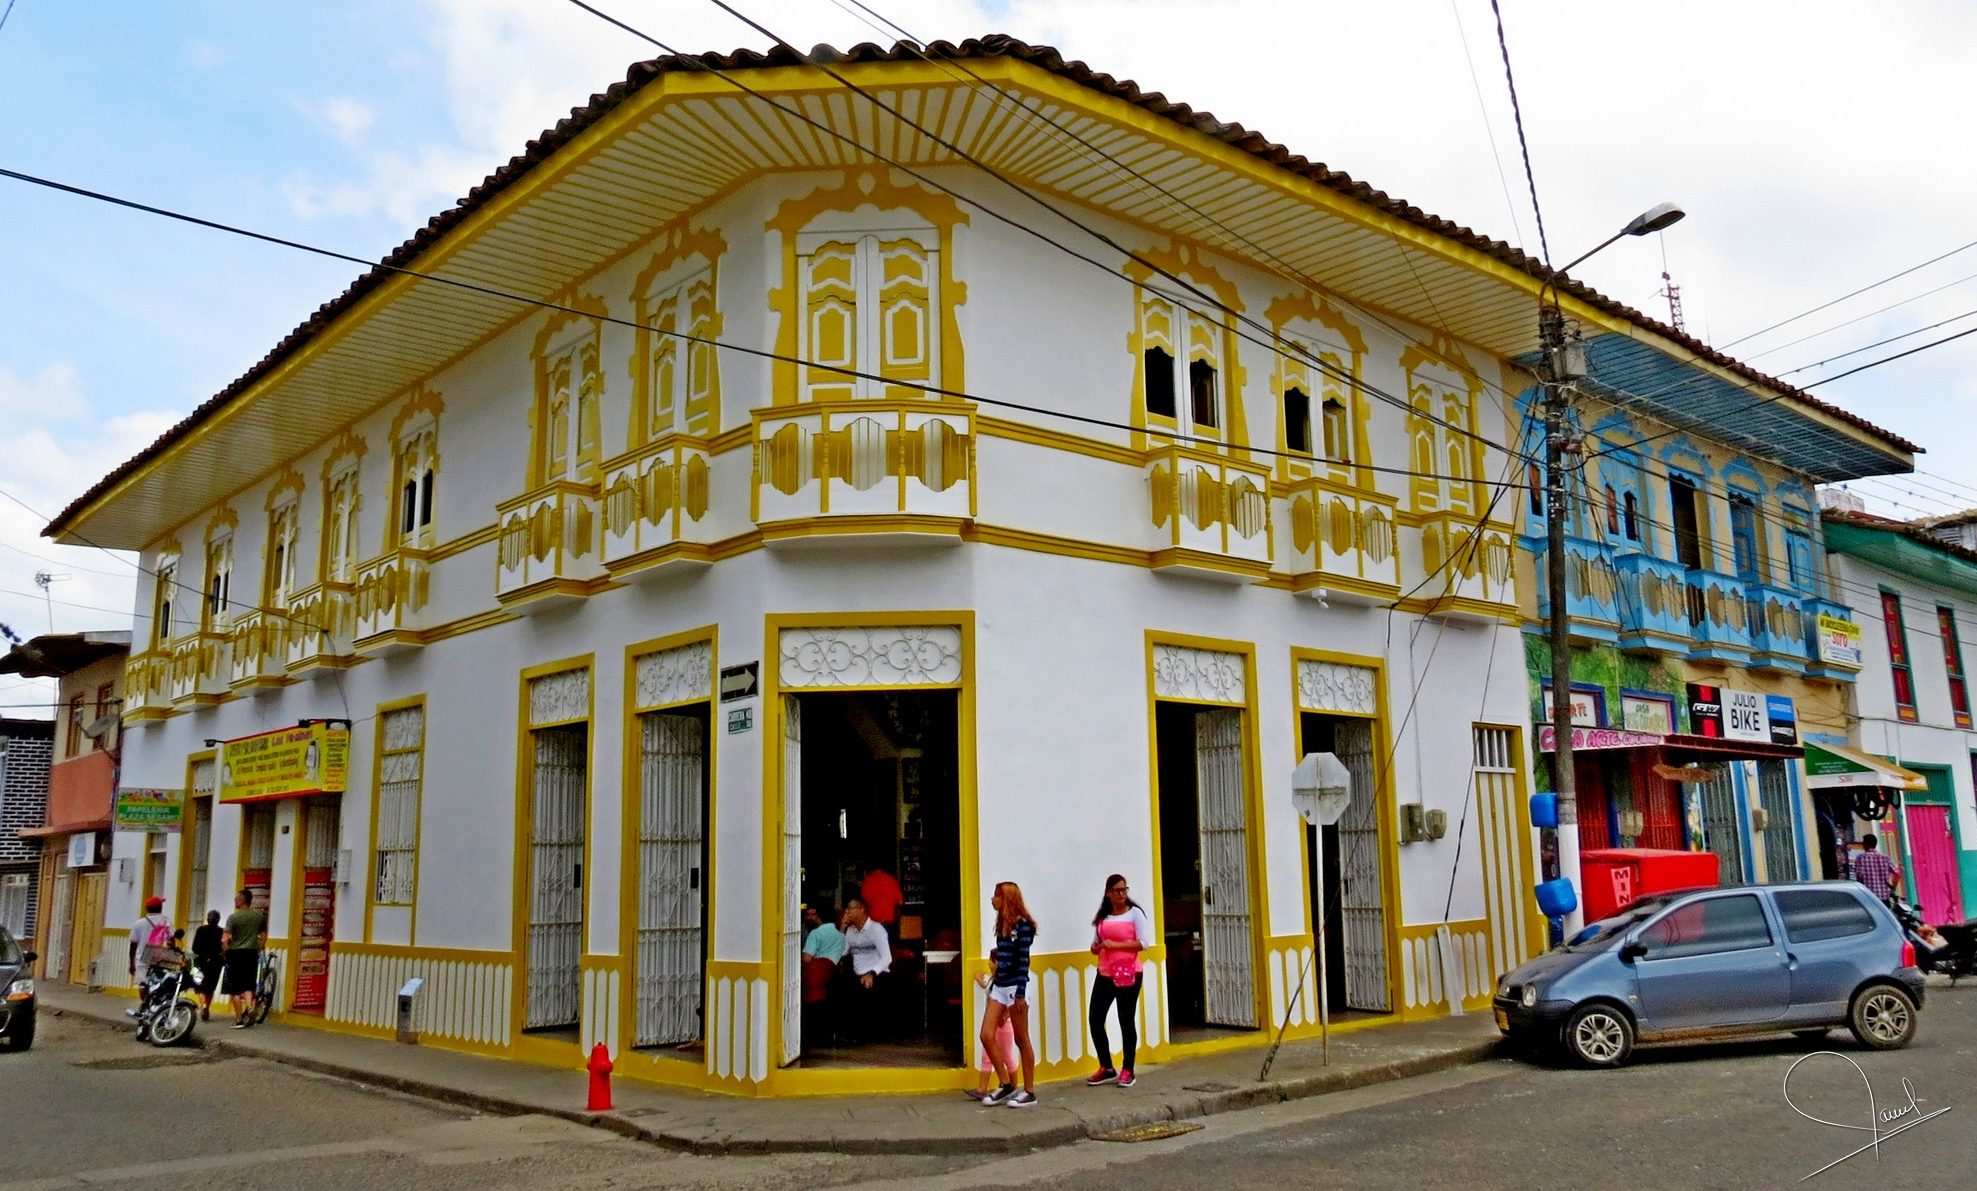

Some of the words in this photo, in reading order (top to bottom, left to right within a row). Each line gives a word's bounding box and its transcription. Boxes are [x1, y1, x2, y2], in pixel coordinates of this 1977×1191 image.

[1733, 693, 1756, 708] JULIO
[1731, 708, 1760, 731] BIKE
[1541, 727, 1584, 750] CA
[1586, 729, 1621, 749] ARTE
